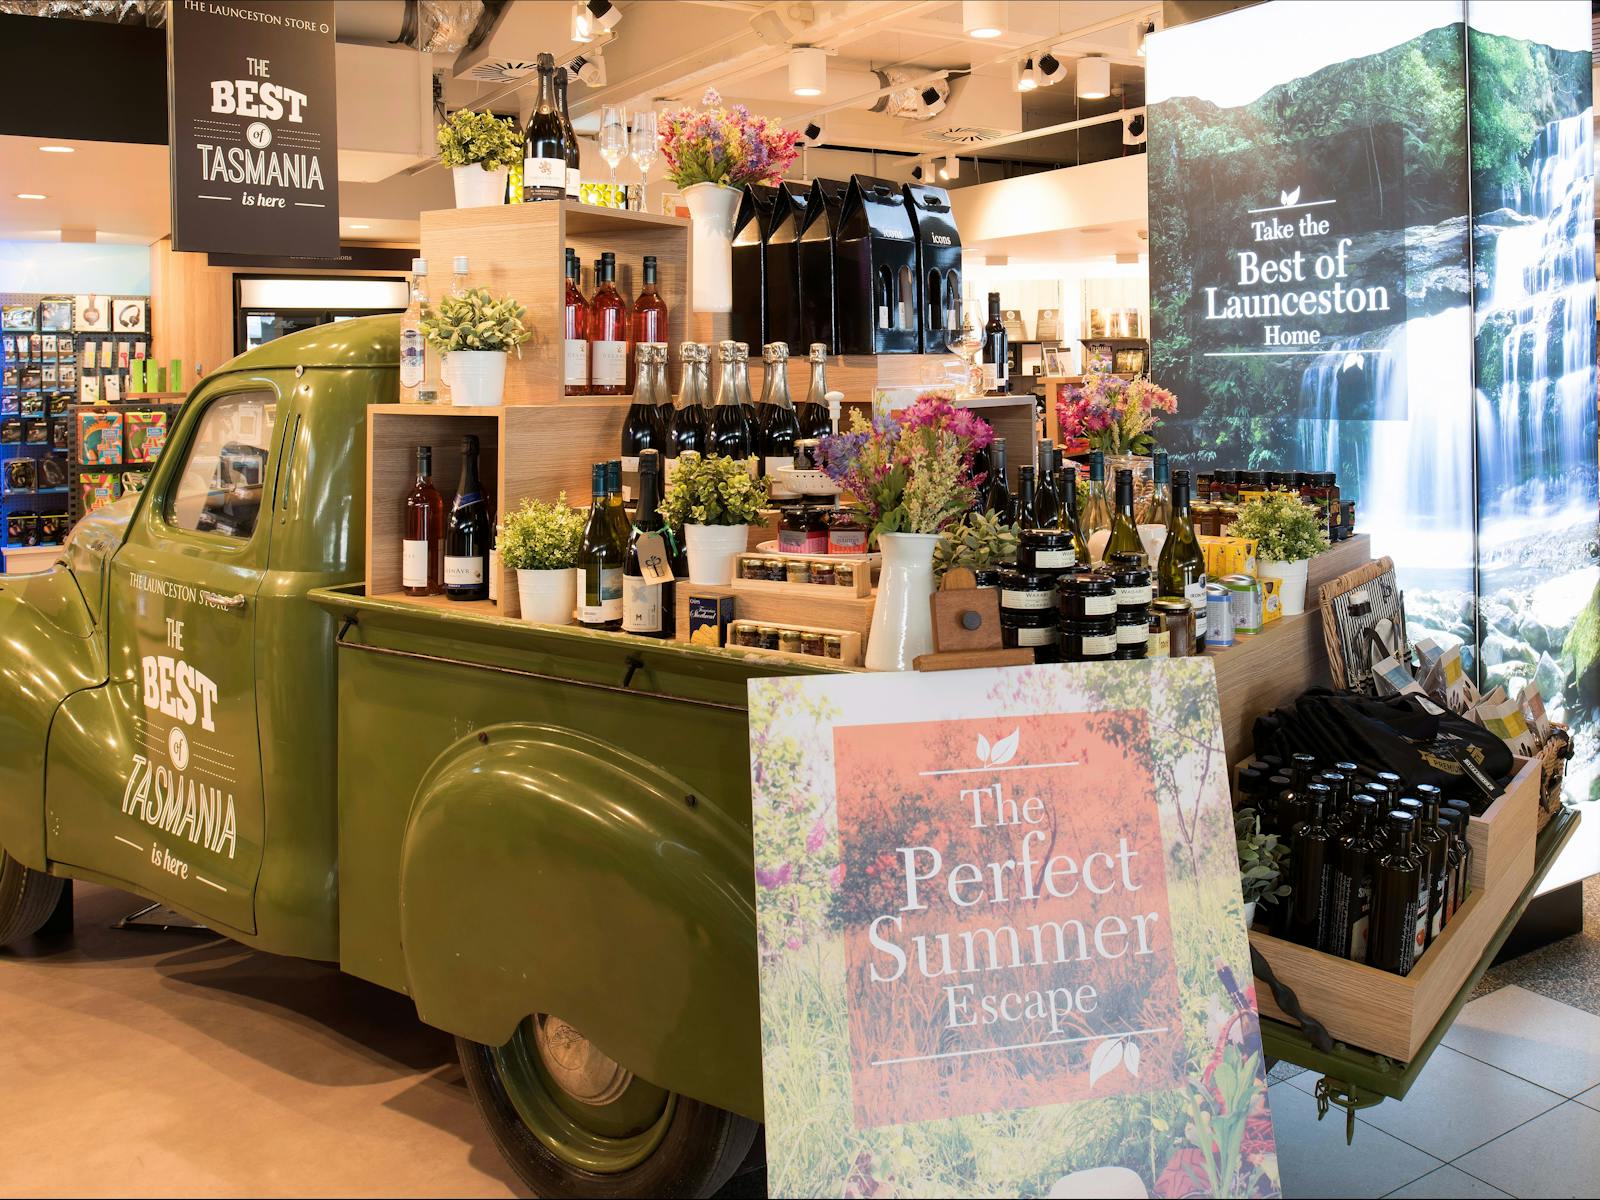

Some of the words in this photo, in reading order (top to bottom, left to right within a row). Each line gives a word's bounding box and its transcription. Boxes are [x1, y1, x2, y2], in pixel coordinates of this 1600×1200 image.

[184, 0, 206, 12] THE
[209, 4, 282, 25] LAUNCESTON
[285, 17, 317, 32] STORE
[246, 57, 270, 78] THE
[210, 79, 308, 124] BEST
[253, 128, 266, 143] of
[196, 143, 325, 190] TASMANIA
[242, 192, 255, 206] is
[257, 193, 287, 208] here
[932, 231, 951, 245] icons
[1251, 218, 1294, 241] Take
[1299, 213, 1330, 237] the
[1237, 250, 1305, 286] Best
[1314, 238, 1352, 279] of
[1205, 282, 1391, 319] Launceston
[1264, 325, 1320, 345] Home
[129, 572, 142, 588] THE
[144, 576, 196, 603] LAUNCESTON
[166, 617, 185, 651] THE
[142, 655, 218, 731] BEST
[173, 739, 184, 761] of
[122, 753, 237, 860] TASMANIA
[960, 782, 1045, 829] The
[151, 842, 163, 867] is
[162, 848, 189, 880] here
[896, 830, 1143, 912] Perfect
[868, 911, 1159, 983] Summer
[944, 983, 1098, 1034] Escape
